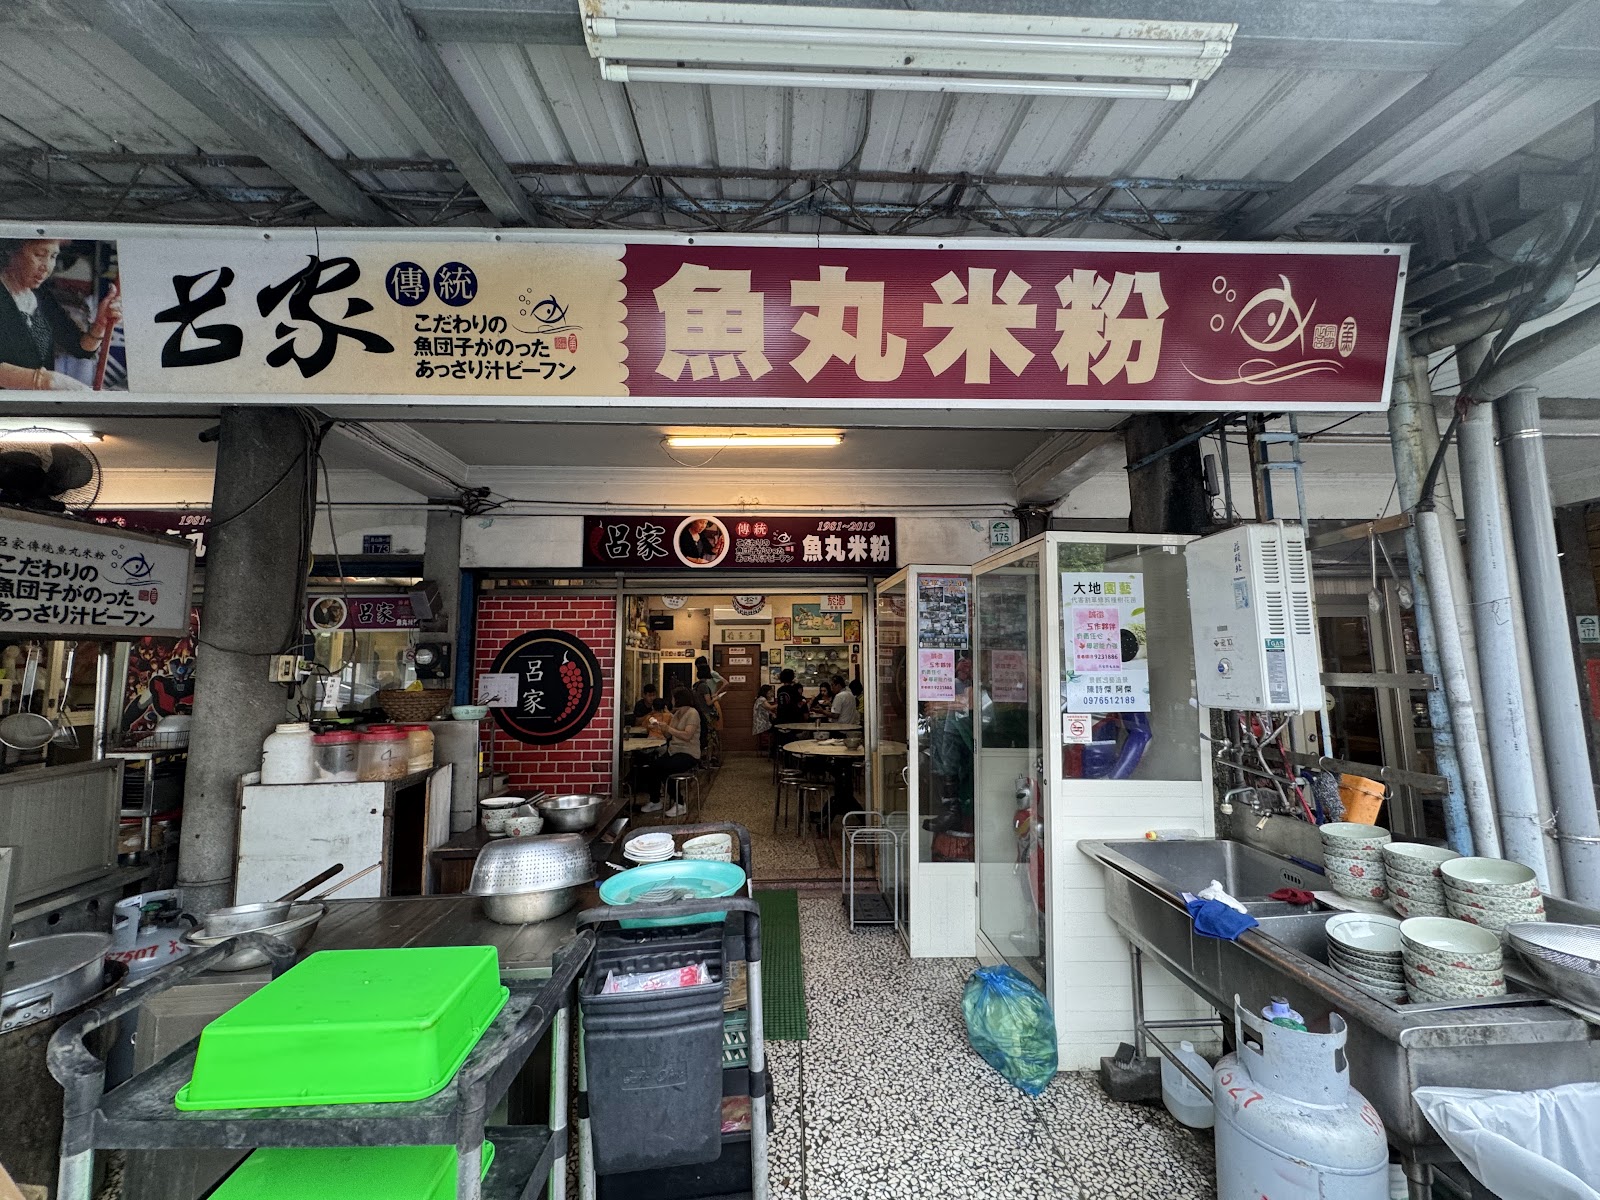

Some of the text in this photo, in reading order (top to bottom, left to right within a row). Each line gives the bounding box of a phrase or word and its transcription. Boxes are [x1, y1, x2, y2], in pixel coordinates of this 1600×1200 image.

[388, 265, 475, 303] 傳統
[155, 254, 394, 378] 呂家
[414, 314, 508, 335] こだわりの
[653, 262, 1169, 387] 魚丸米粉
[413, 335, 550, 359] 魚団子がのった
[415, 360, 577, 381] あっさり汁ビーフン
[816, 521, 876, 531] 1981~2019
[994, 532, 1009, 542] 175
[605, 522, 669, 561] 呂家
[802, 534, 890, 562] 魚丸米粉
[0, 554, 99, 582] こだわりの
[358, 602, 396, 624] 呂家
[522, 659, 546, 714] 呂家
[1083, 696, 1135, 705] 0976512189
